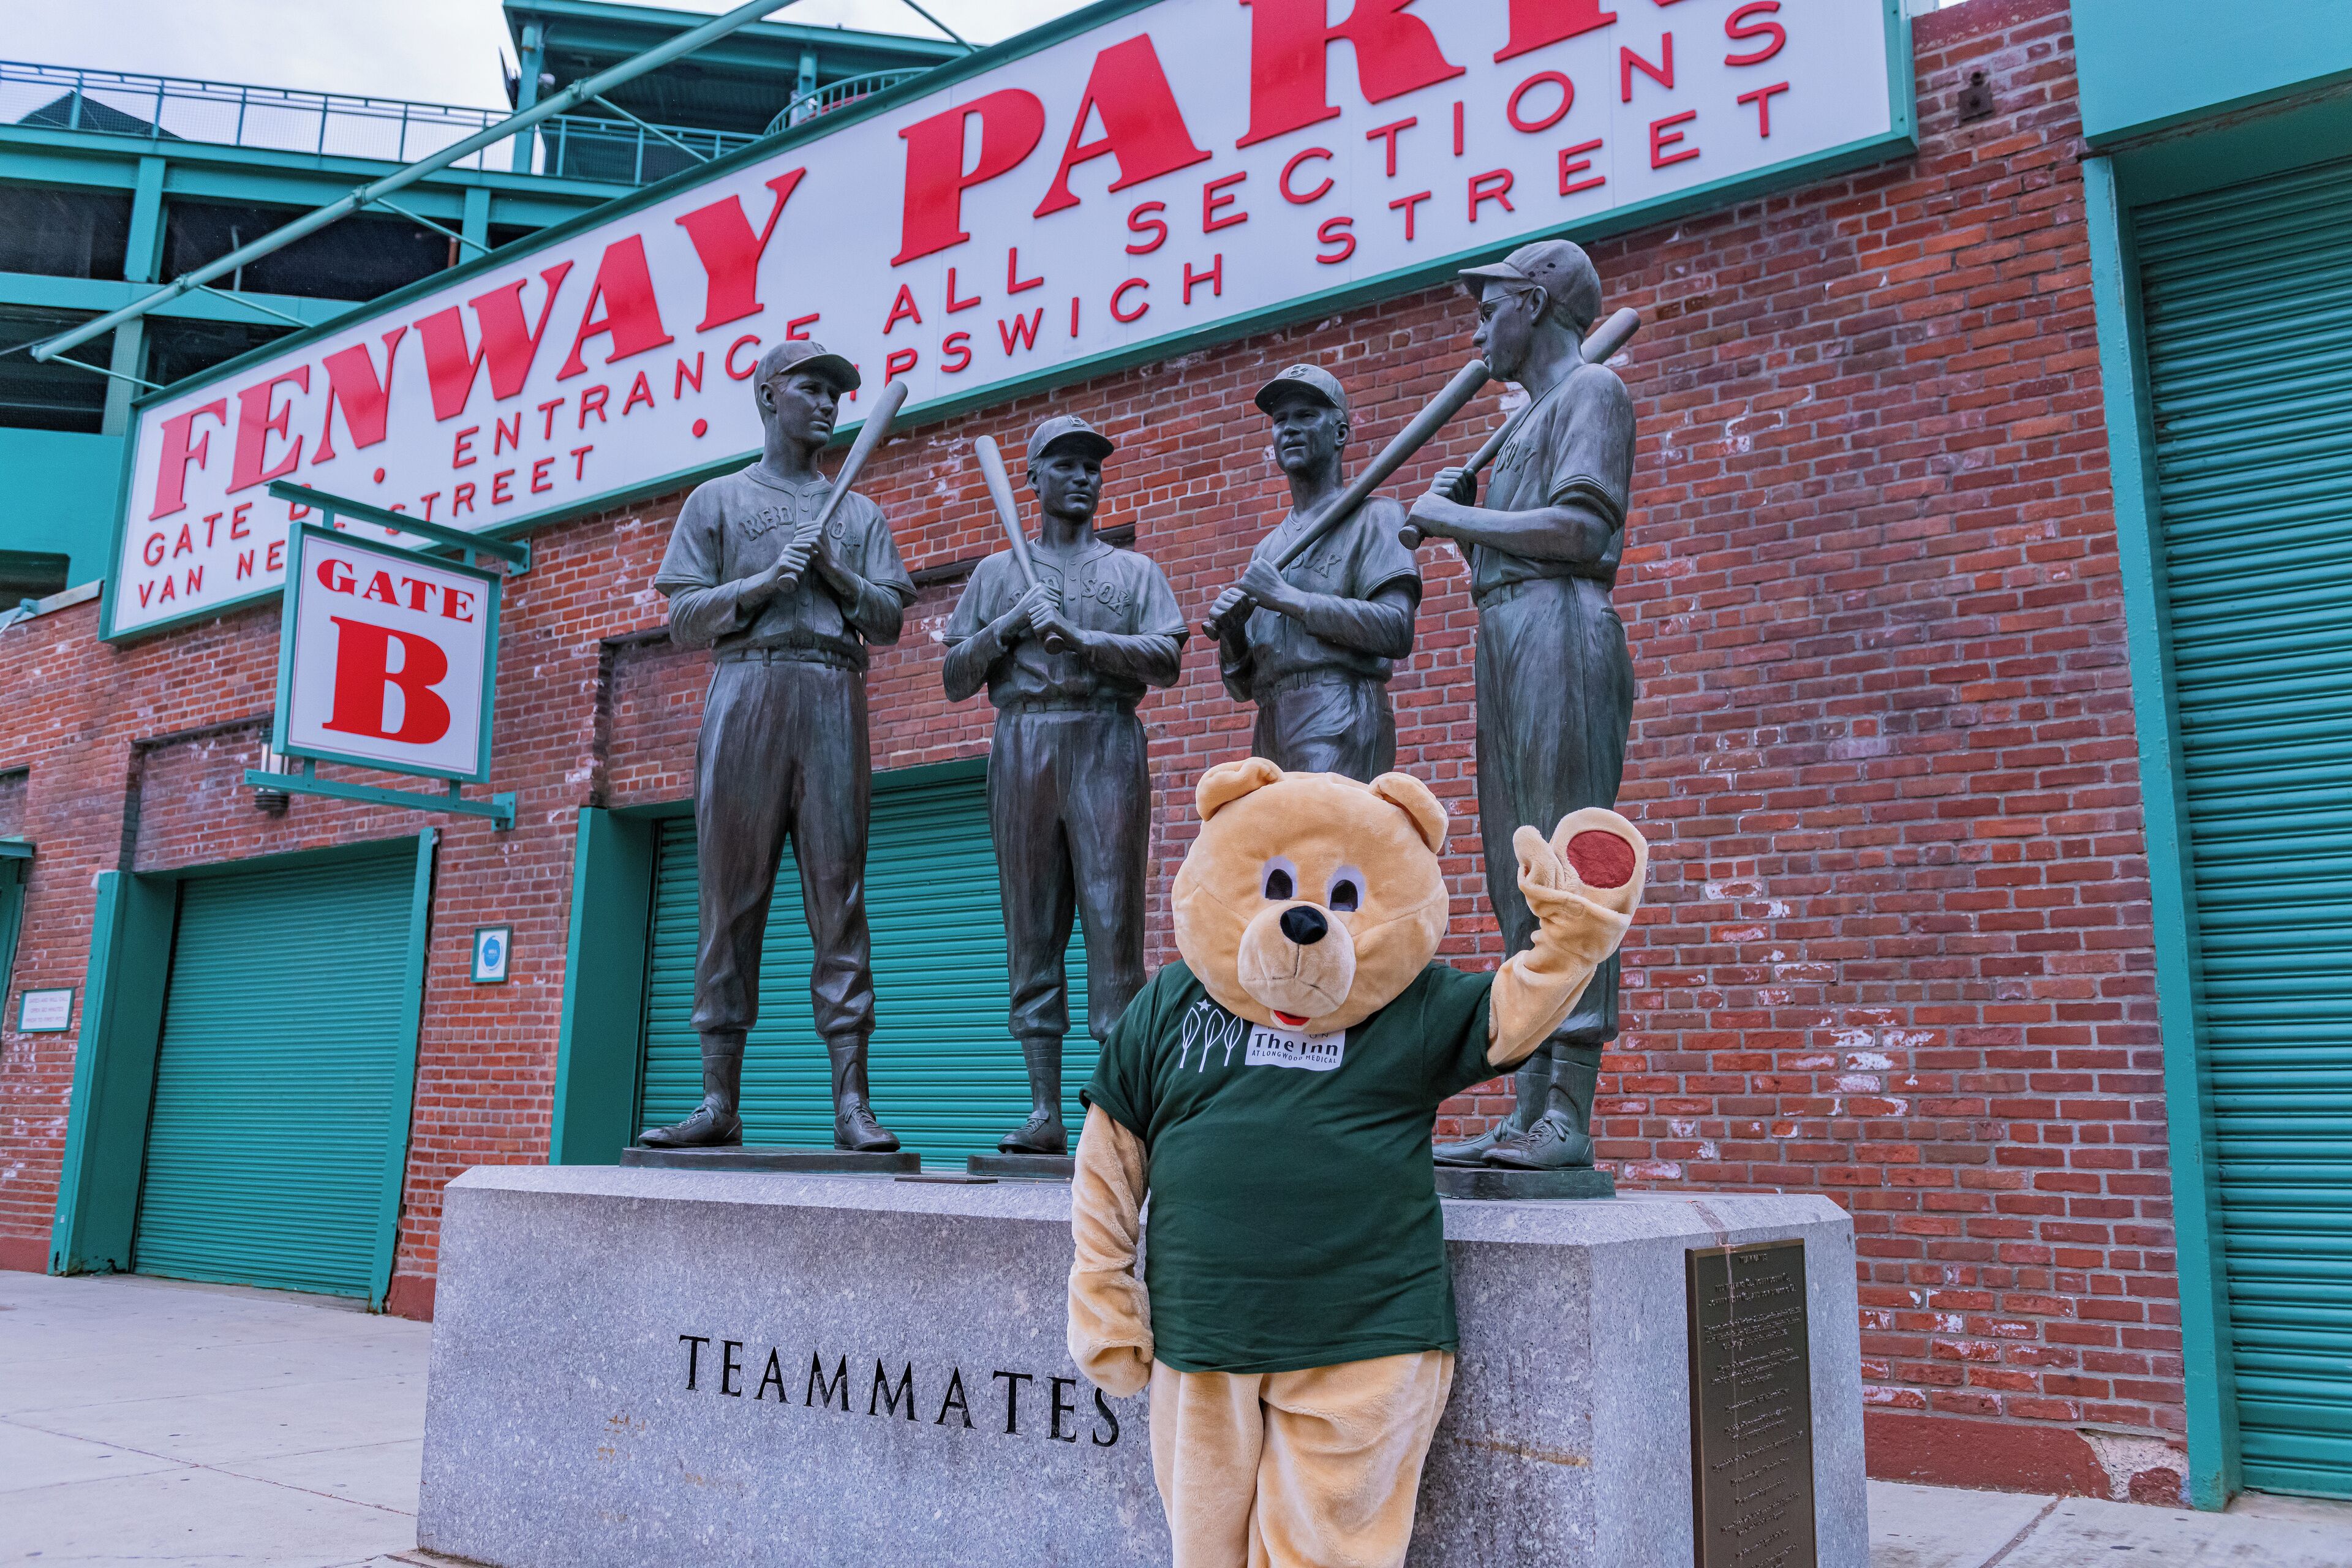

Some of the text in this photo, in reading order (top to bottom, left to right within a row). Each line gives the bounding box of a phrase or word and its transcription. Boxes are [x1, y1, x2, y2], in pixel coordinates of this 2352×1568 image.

[143, 502, 253, 567] GATE
[883, 246, 1044, 334] ALL
[1125, 0, 1787, 256] SECTIONS
[149, 0, 1679, 521] FENWAY PAR
[138, 565, 203, 608] VAN
[1315, 81, 1790, 265] STREET
[739, 504, 794, 542] RED
[316, 558, 474, 624] GATE
[1081, 578, 1131, 617] SOX
[321, 614, 451, 745] B
[1254, 1033, 1338, 1057] The Inn
[1262, 1050, 1303, 1061] LONGWOOD
[1305, 1055, 1336, 1063] MEDICAL
[677, 1334, 1120, 1448] TEAMMATES
